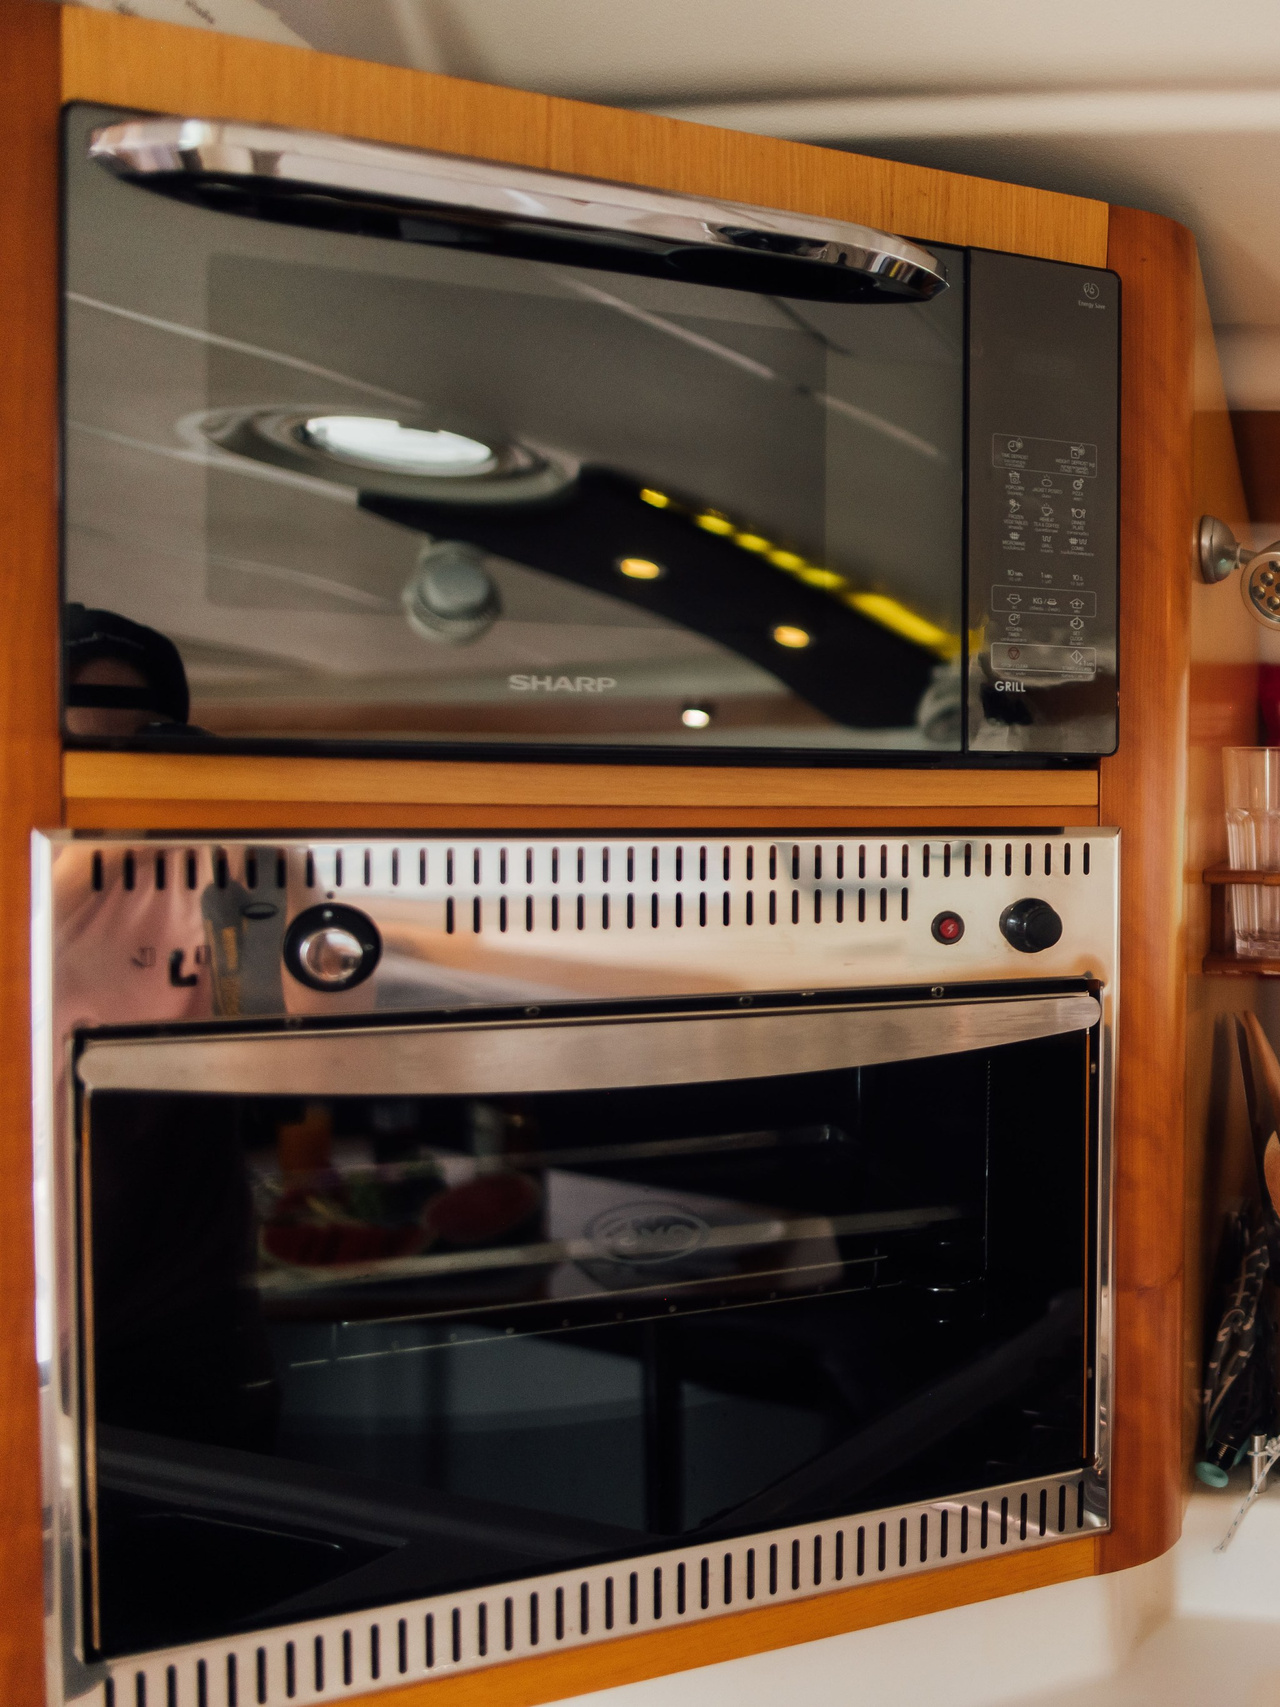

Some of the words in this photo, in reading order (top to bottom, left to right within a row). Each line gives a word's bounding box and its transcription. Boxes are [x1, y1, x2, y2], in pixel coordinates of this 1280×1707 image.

[1032, 597, 1042, 605] KG
[508, 674, 618, 693] SHARP
[994, 681, 1026, 693] GRILL
